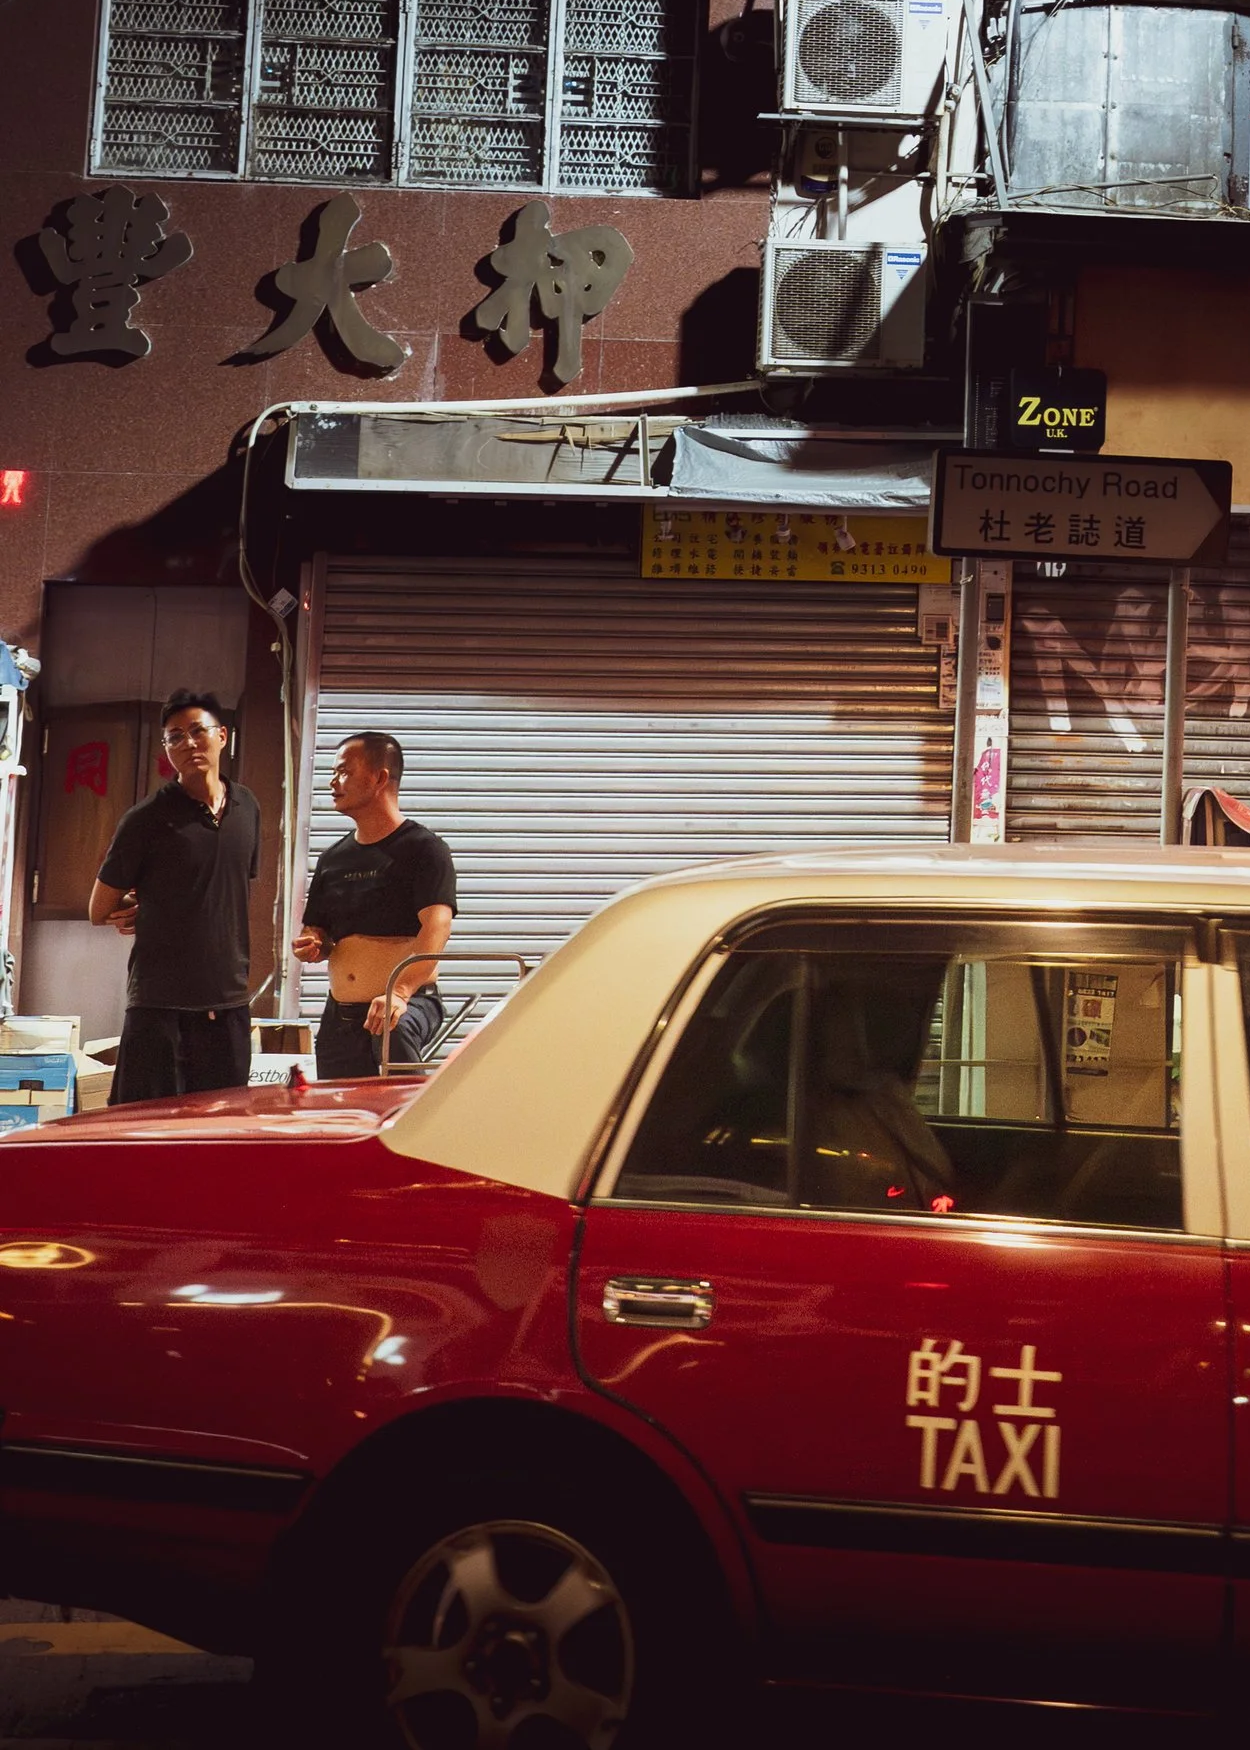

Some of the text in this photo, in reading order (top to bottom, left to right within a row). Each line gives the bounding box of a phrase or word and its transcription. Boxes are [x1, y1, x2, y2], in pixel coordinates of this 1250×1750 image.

[1046, 428, 1068, 439] U.K.
[953, 464, 1178, 500] Tonnochy Road
[979, 508, 1147, 550] 杜老誌道
[851, 563, 928, 577] 9313 0490
[905, 1337, 1063, 1419] 的士
[904, 1414, 1063, 1500] TAXI
